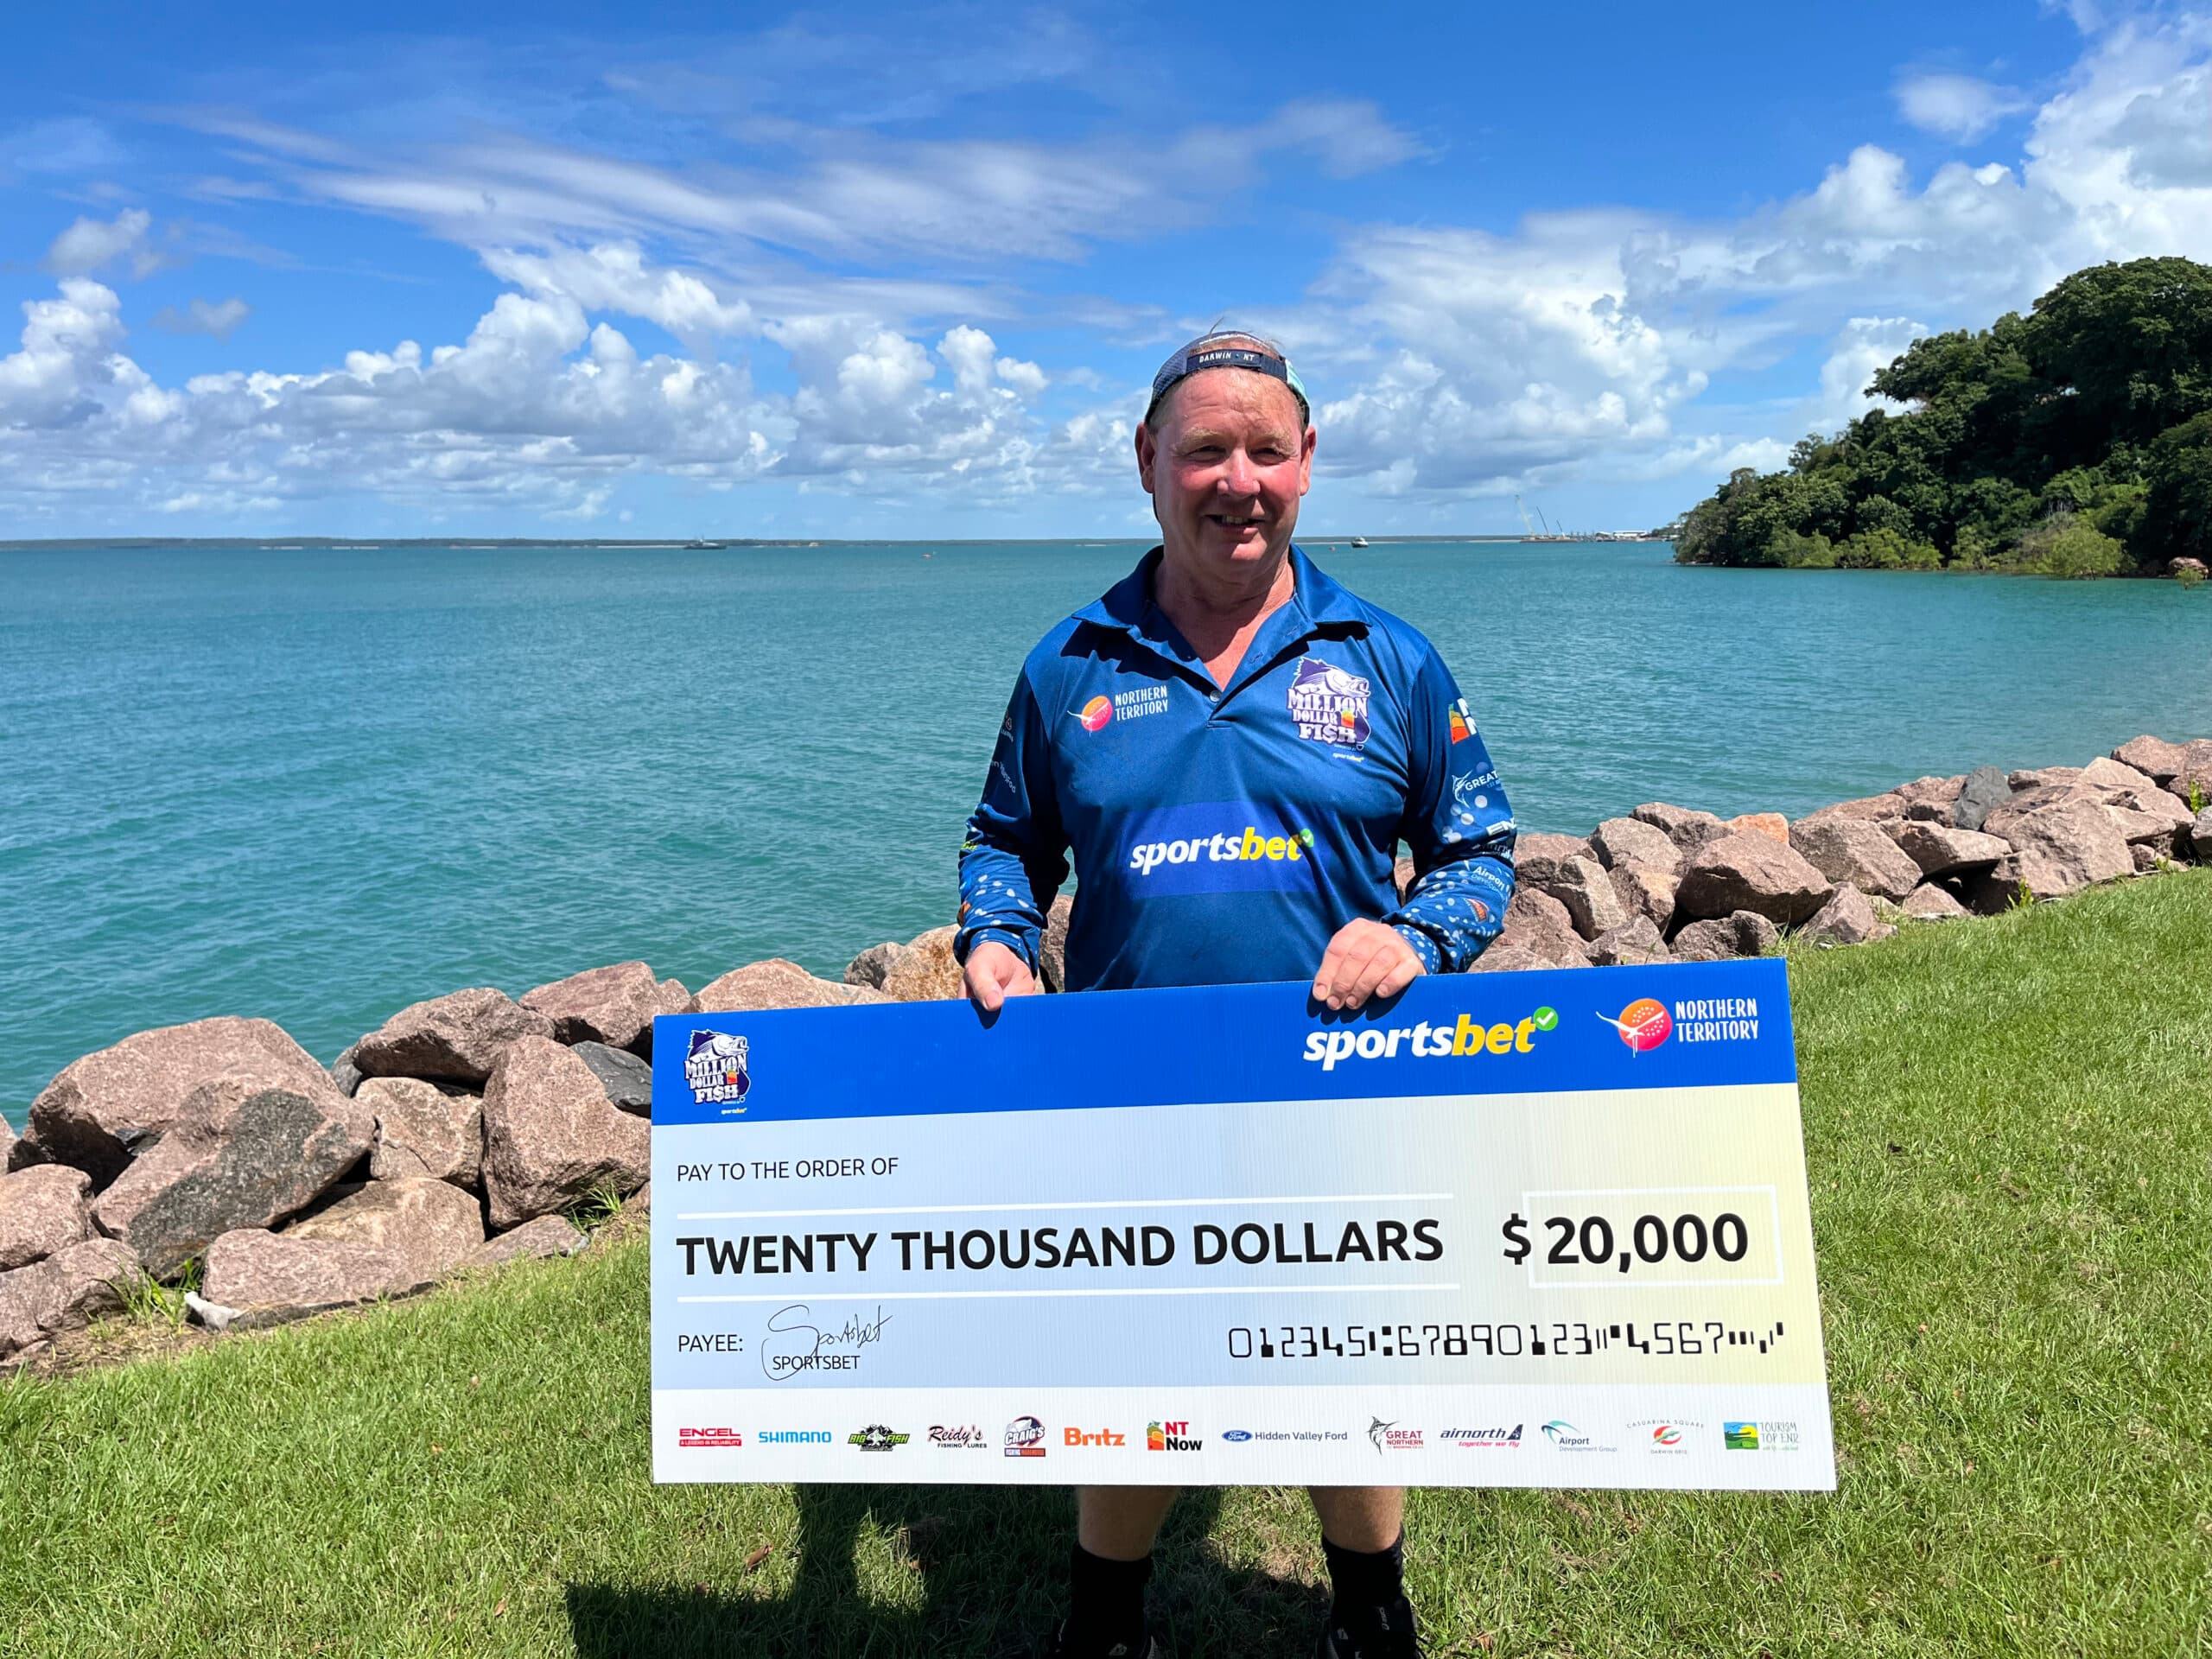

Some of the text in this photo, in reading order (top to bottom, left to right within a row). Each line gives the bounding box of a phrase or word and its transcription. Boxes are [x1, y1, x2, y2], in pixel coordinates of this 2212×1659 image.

[1198, 352, 1231, 364] DARWIN
[1115, 685, 1167, 706] NORTHERN
[1287, 688, 1368, 718] MILLION
[1115, 699, 1168, 721] TERRITORY
[1293, 709, 1338, 725] DOLLAR
[1465, 770, 1499, 791] GREAT
[1130, 827, 1302, 875] sportsbet
[1675, 998, 1758, 1020] NORTHERN
[1676, 1020, 1759, 1042] TERRITORY
[1303, 1014, 1536, 1071] sportsbet
[684, 1052, 747, 1079] MILLION
[690, 1074, 724, 1090] DOLLAR
[677, 1157, 899, 1182] PAY TO THE ORDER OF
[676, 1218, 1444, 1275] TWENTY THOUSAND DOLLARS
[677, 1333, 744, 1352] PAYEE:
[772, 1355, 861, 1370] SPORTSBET
[679, 1427, 741, 1437] ENGEL
[1165, 1421, 1189, 1436] NT
[1440, 1427, 1507, 1439] airnorth
[1625, 1419, 1704, 1429] CASUARINA SQUARE
[759, 1431, 832, 1444] SHIMANO
[849, 1433, 910, 1444] BIG FISH
[928, 1425, 983, 1446] Reidy's
[1005, 1425, 1046, 1446] CRAIG'S
[1064, 1427, 1126, 1446] Britz
[1255, 1432, 1348, 1442] Hidden Valley Ford
[1386, 1430, 1423, 1439] GREAT
[1559, 1436, 1590, 1446] Airport
[1166, 1437, 1203, 1452] Now
